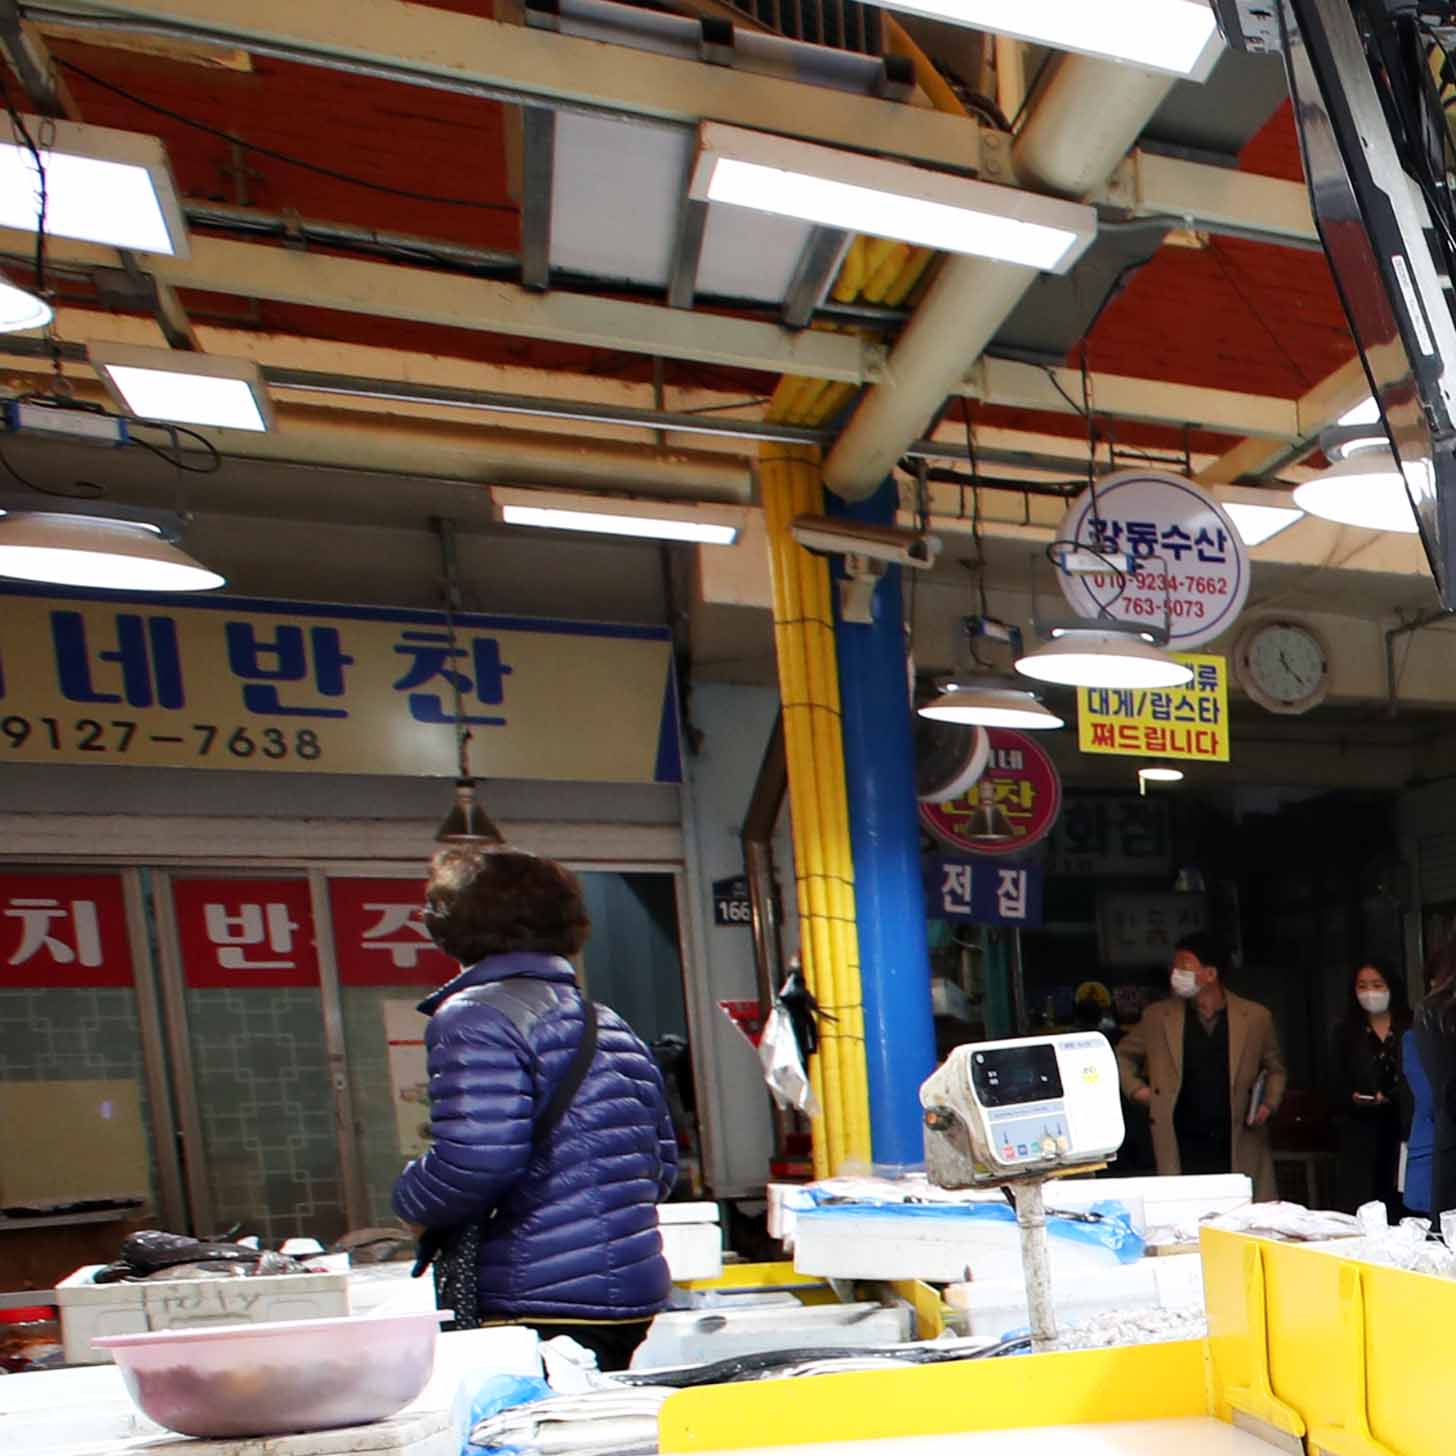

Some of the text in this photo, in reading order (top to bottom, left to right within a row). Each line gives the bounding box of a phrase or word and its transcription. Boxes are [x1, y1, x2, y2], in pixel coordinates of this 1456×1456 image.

[1087, 687, 1220, 725] 대게/랍스타
[1091, 722, 1219, 756] 쪄드립니다
[4, 898, 104, 968] 치
[204, 903, 299, 969] 반
